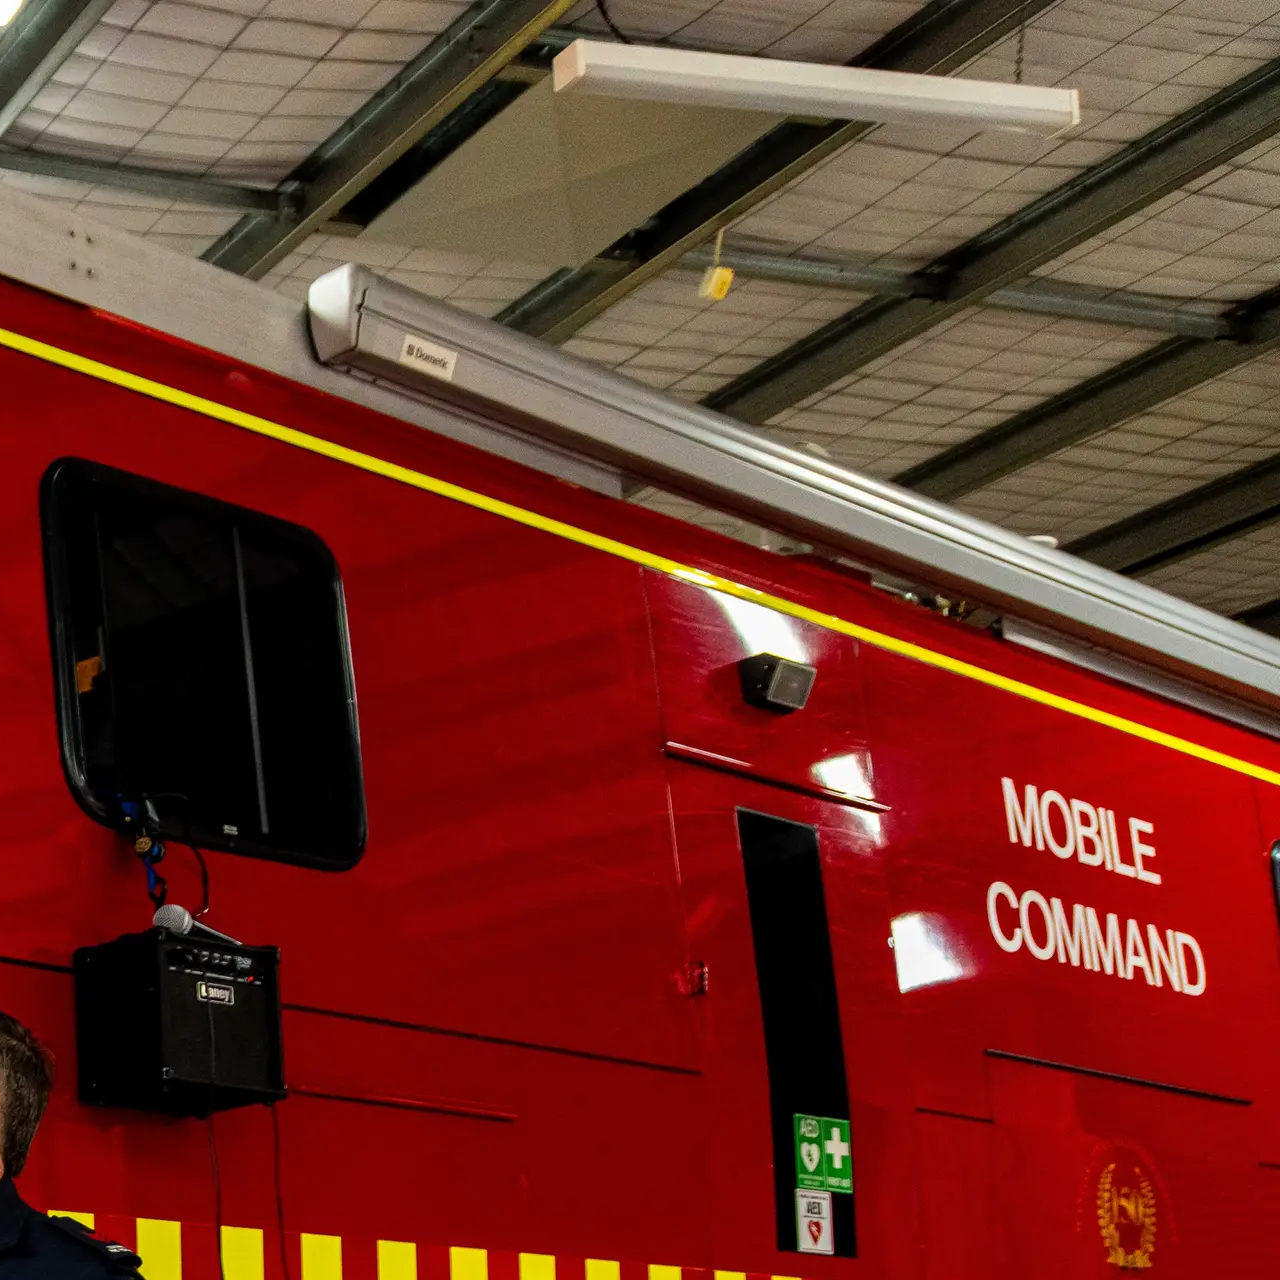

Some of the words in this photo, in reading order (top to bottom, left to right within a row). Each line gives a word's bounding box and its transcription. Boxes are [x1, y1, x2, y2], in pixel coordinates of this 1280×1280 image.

[1001, 776, 1162, 885] MOBILE
[200, 983, 230, 1002] Laney
[987, 881, 1206, 996] COMMAND
